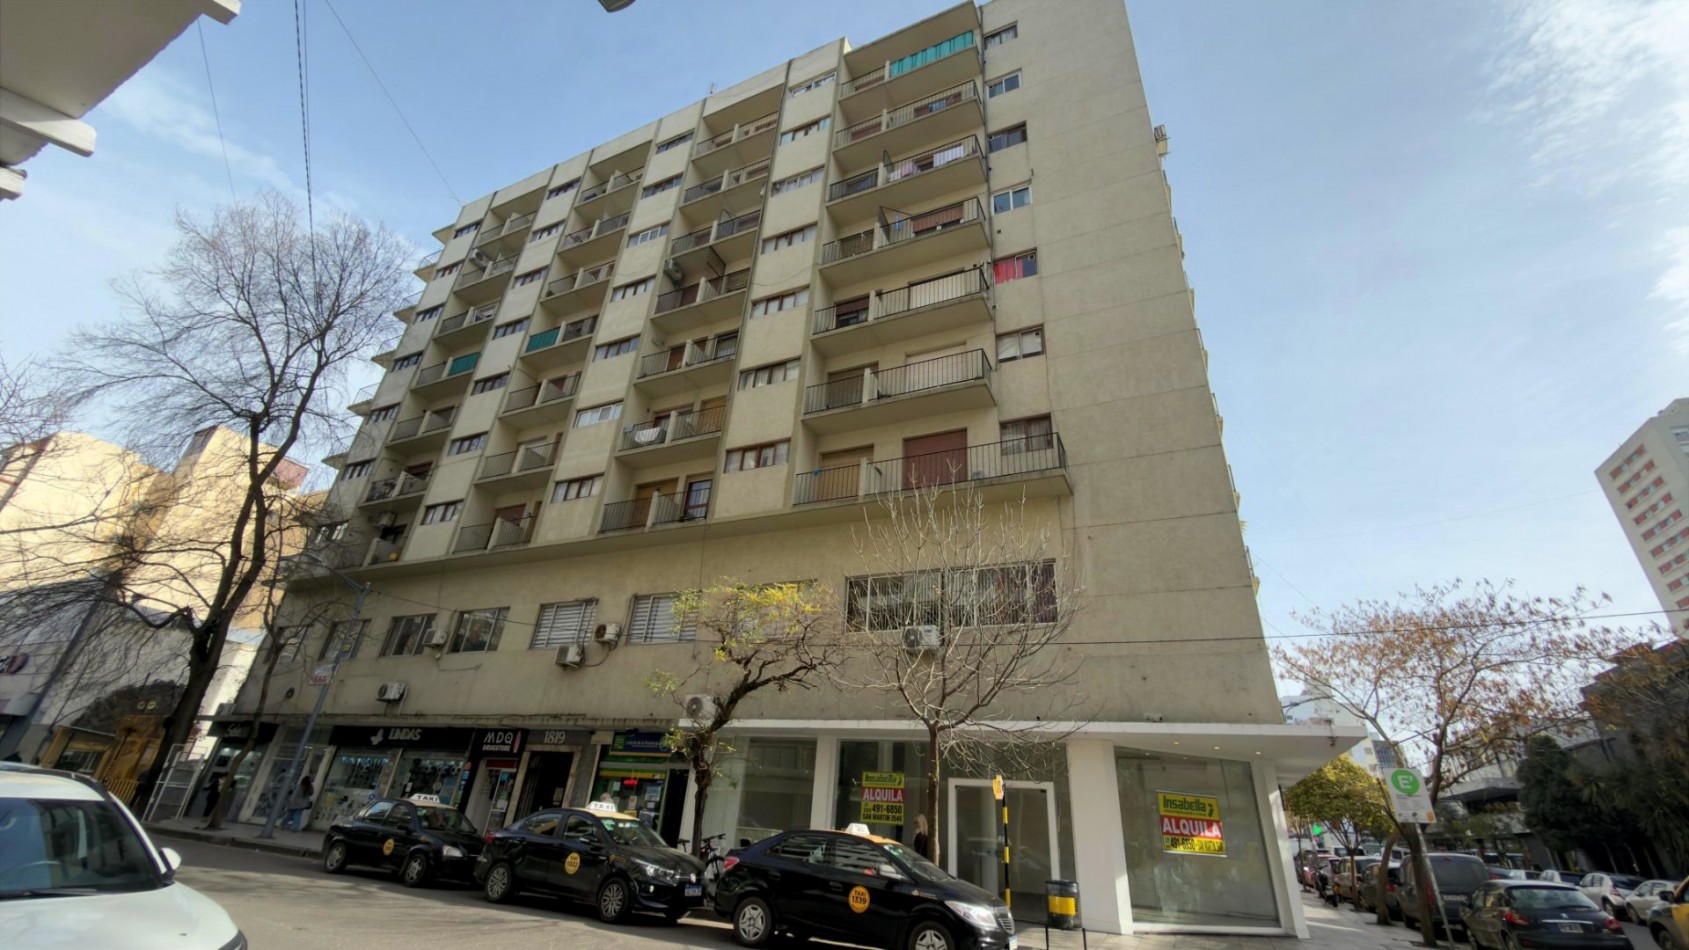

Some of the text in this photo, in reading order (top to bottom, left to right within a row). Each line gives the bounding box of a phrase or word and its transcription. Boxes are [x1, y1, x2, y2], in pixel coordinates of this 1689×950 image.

[483, 731, 514, 744] MDQ
[543, 730, 566, 744] 1819
[481, 744, 511, 752] DRUGSTORE
[862, 788, 904, 802] ALQUILA
[1163, 795, 1206, 812] Insabella
[873, 813, 890, 821] MARTIN
[1163, 817, 1222, 838] ALQUILA
